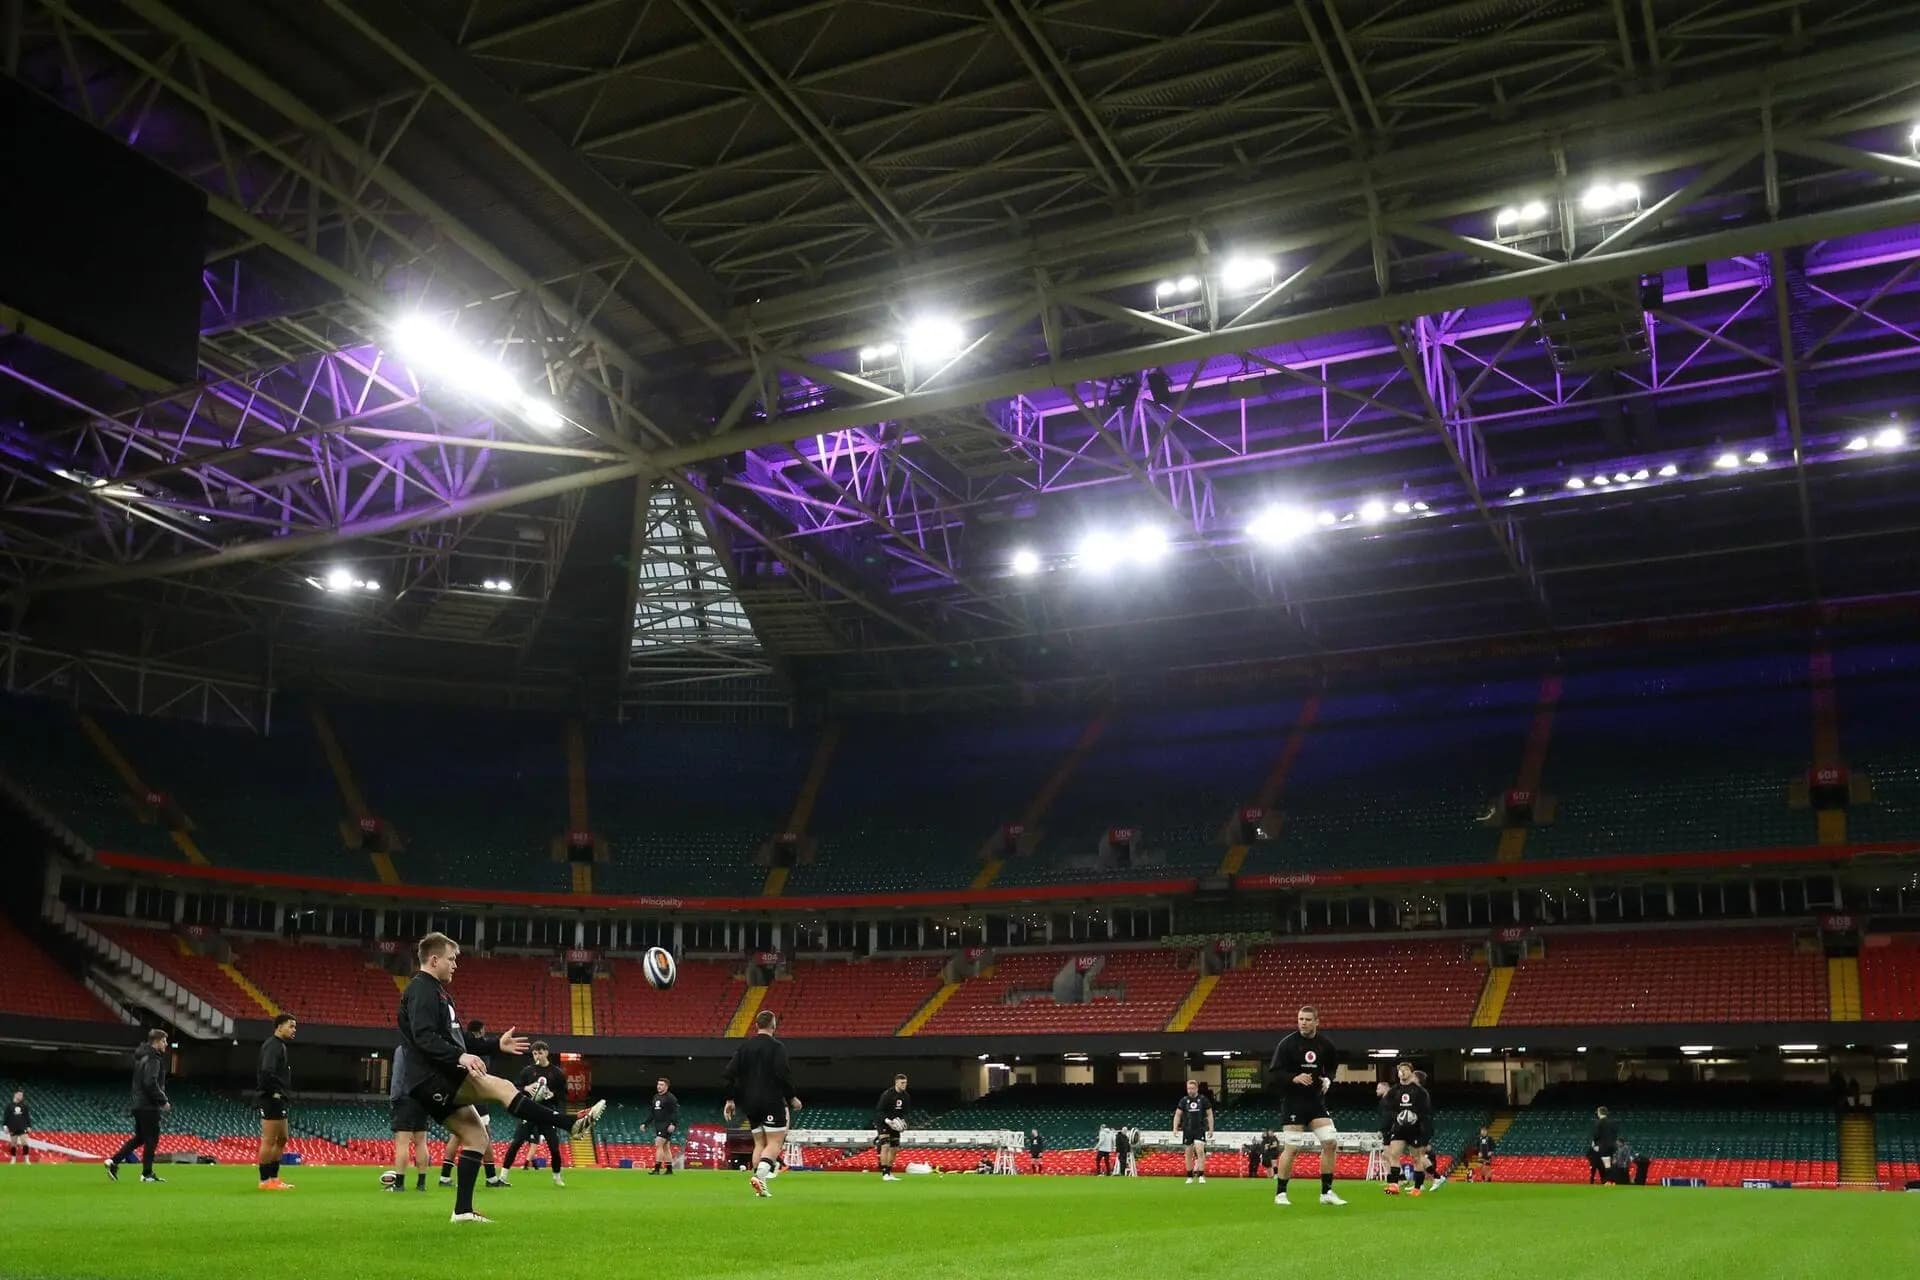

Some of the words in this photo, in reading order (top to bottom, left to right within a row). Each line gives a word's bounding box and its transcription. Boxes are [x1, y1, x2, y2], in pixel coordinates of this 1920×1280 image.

[1269, 874, 1317, 885] Principality
[640, 897, 683, 908] Principality
[379, 942, 396, 952] 402
[761, 952, 778, 961] 404
